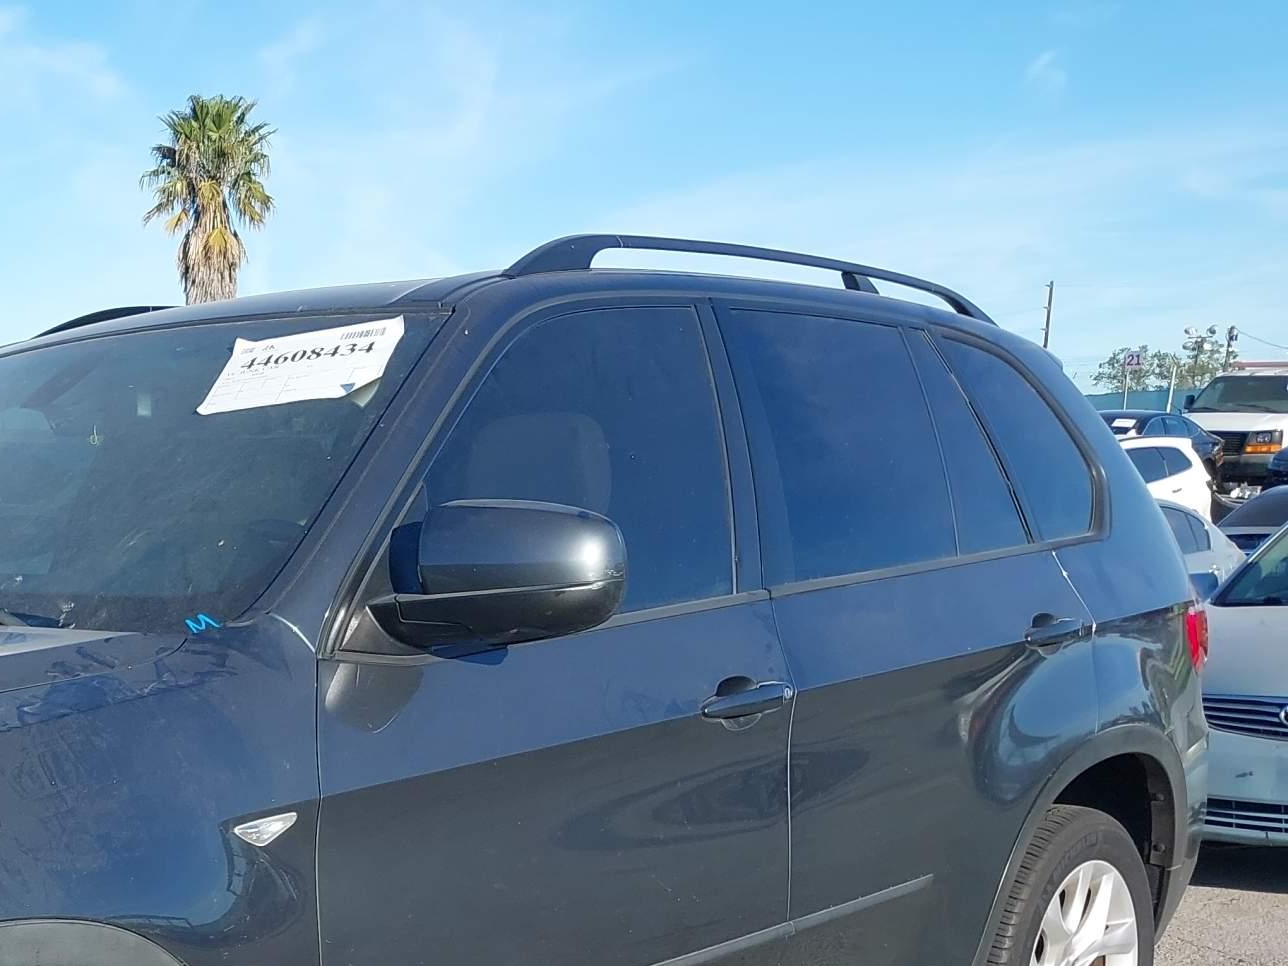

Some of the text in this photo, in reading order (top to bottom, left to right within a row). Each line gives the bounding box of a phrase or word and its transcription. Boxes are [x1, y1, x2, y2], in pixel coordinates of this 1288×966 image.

[240, 341, 376, 371] 44608434
[1126, 353, 1142, 367] 21
[184, 612, 222, 635] M
